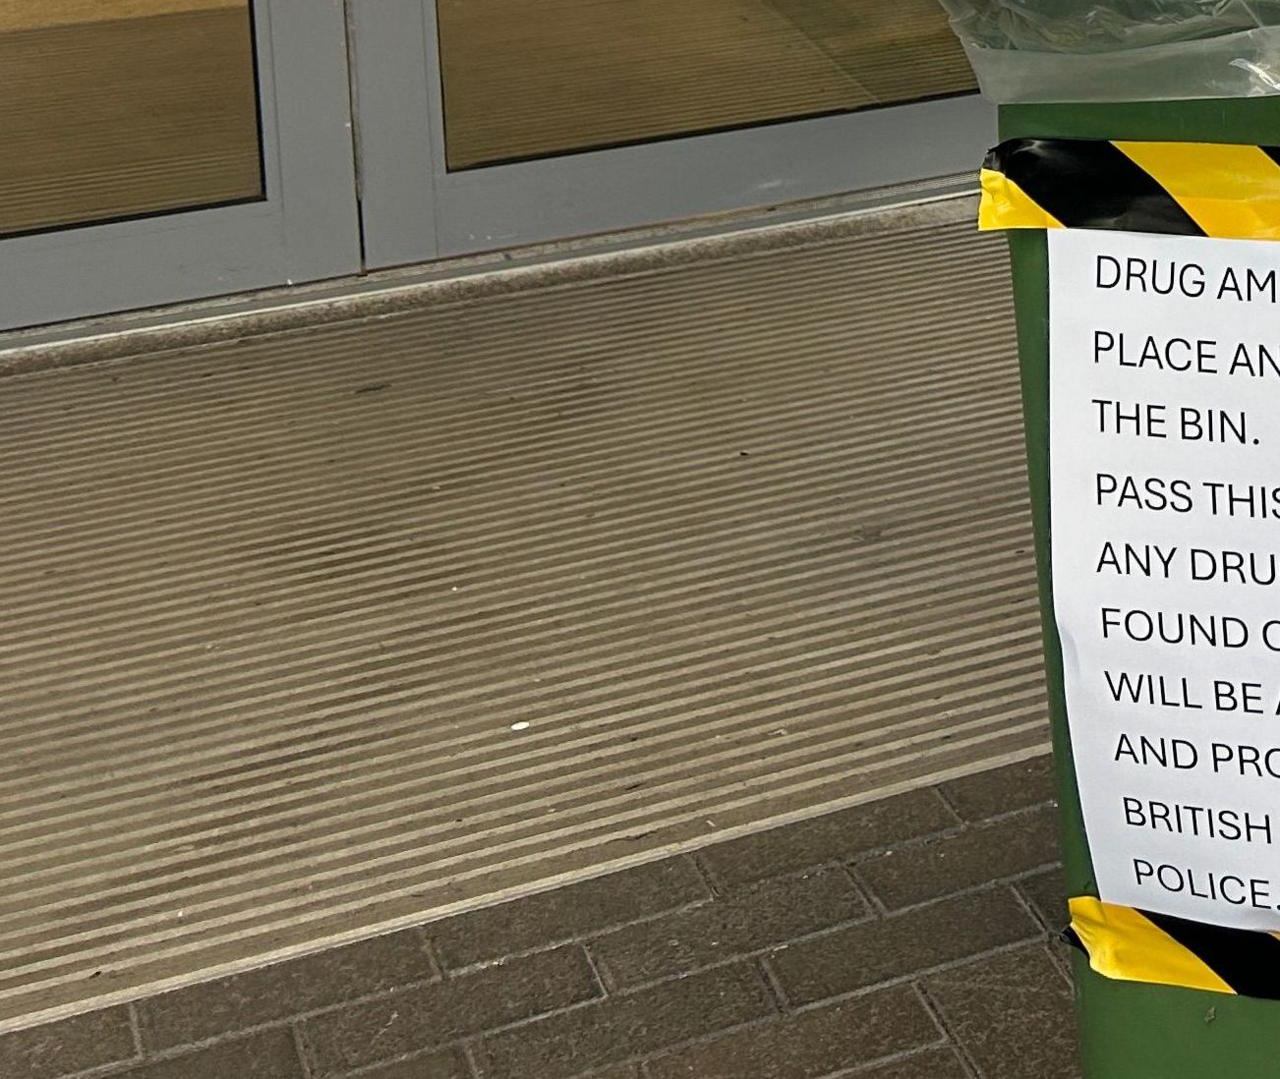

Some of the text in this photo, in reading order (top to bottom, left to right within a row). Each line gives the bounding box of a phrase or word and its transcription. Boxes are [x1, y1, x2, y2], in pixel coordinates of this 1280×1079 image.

[1096, 254, 1206, 298] DRUG
[1094, 330, 1218, 374] PLACE
[1091, 399, 1260, 446] THE BIN.
[1096, 473, 1193, 513] PASS
[1096, 541, 1178, 579] ANY
[1101, 607, 1249, 649] FOUND
[1103, 670, 1203, 710] WILL
[1213, 680, 1264, 715] BE
[1114, 733, 1198, 770] AND
[1122, 796, 1272, 845] BRITISH
